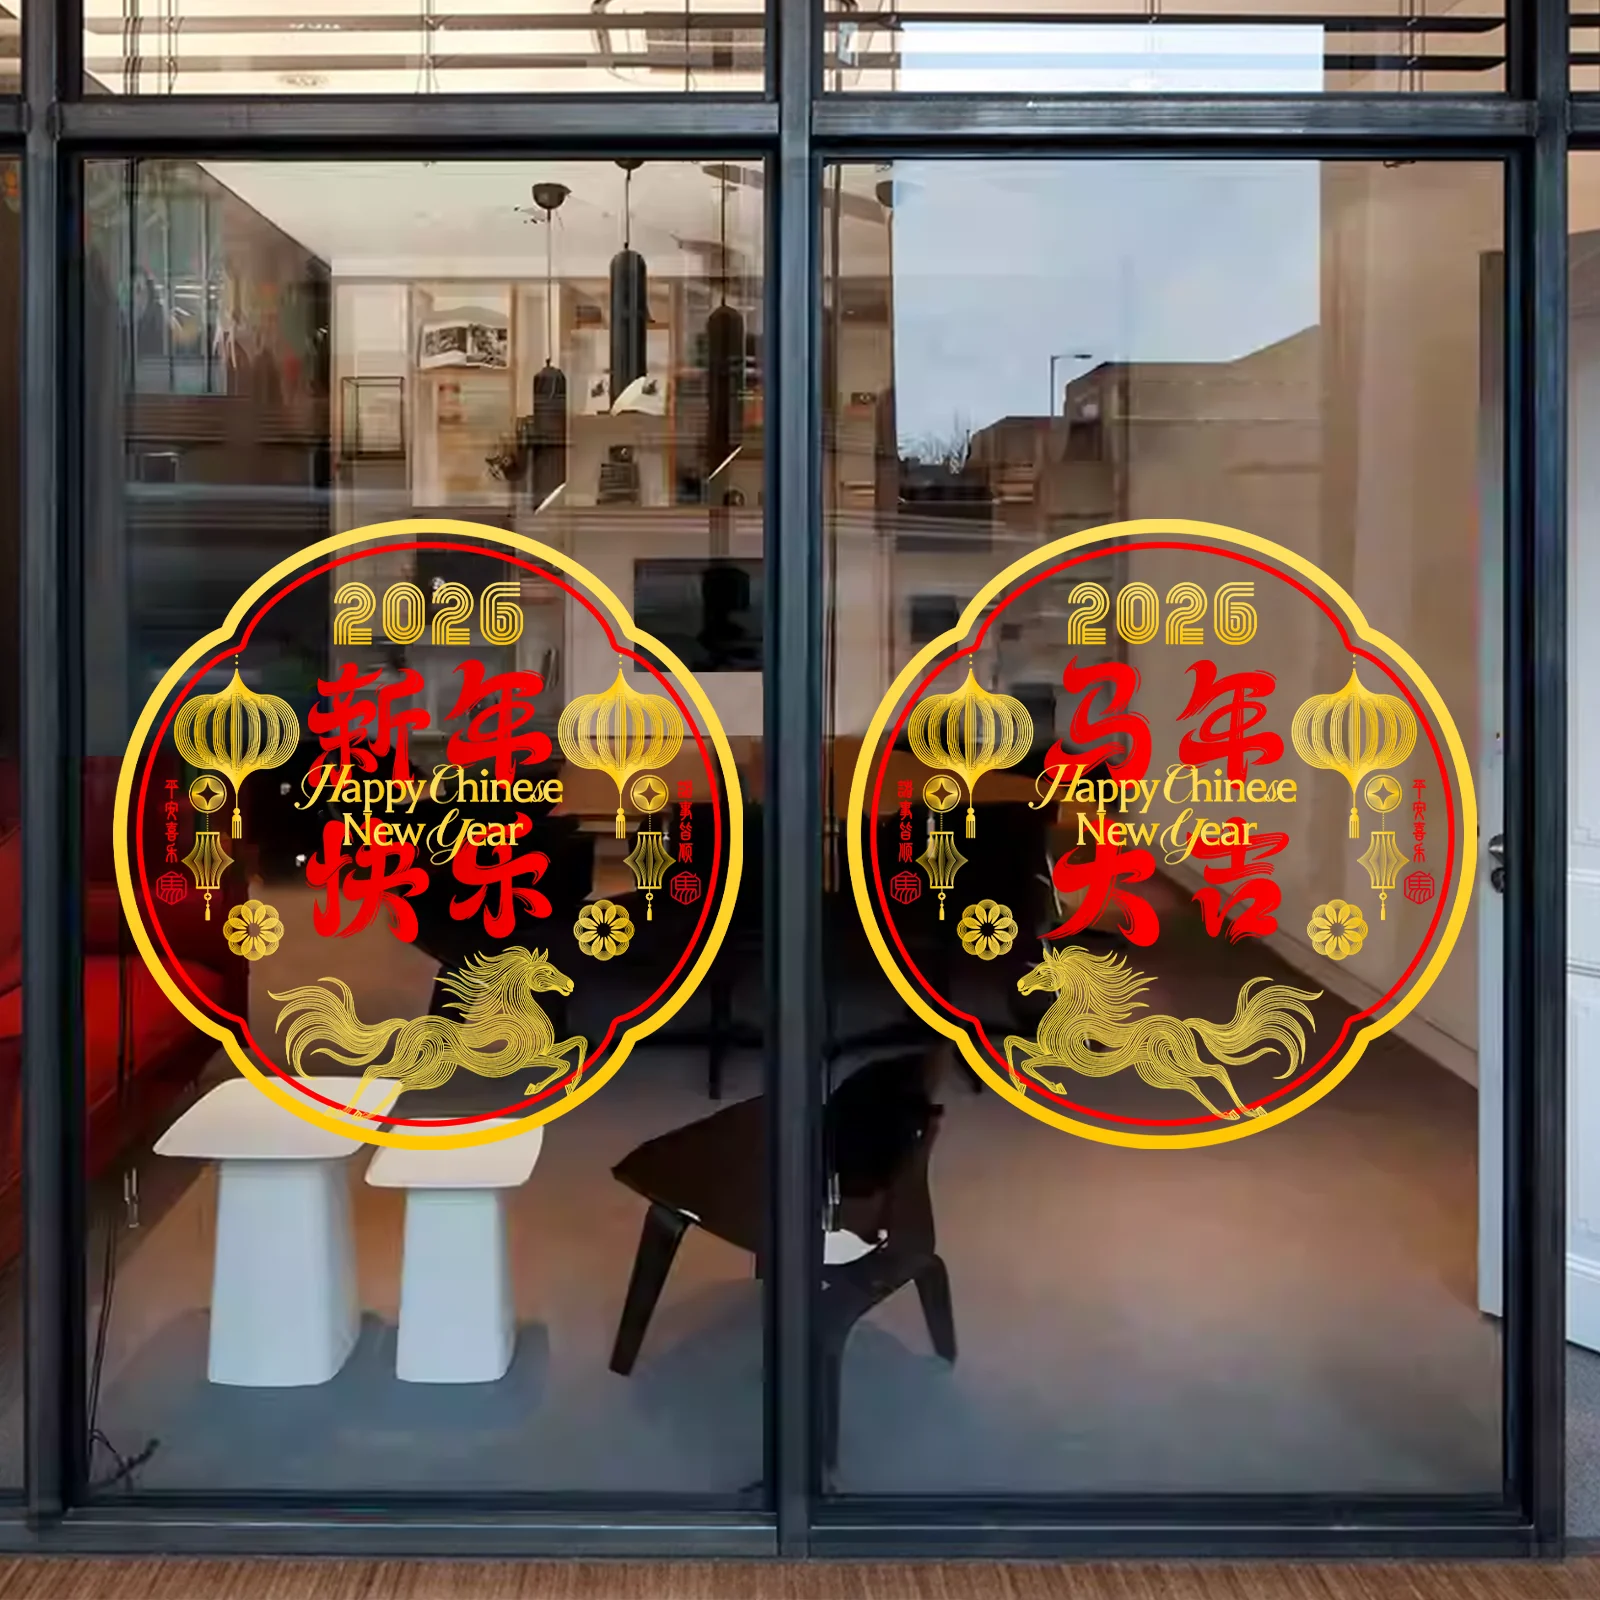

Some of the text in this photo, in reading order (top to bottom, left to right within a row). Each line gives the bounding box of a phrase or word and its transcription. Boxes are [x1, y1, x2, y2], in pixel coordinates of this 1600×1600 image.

[333, 581, 524, 646] 2026
[1067, 581, 1258, 646] 2026
[307, 659, 553, 789] 新年
[1043, 655, 1285, 790] 马年
[294, 763, 564, 814] Happy Chinese
[1028, 763, 1298, 814] Happy Chinese
[342, 807, 524, 866] New Year
[1076, 807, 1258, 865] New Year
[306, 811, 553, 943] 快乐
[1037, 816, 1290, 947] 大吉
